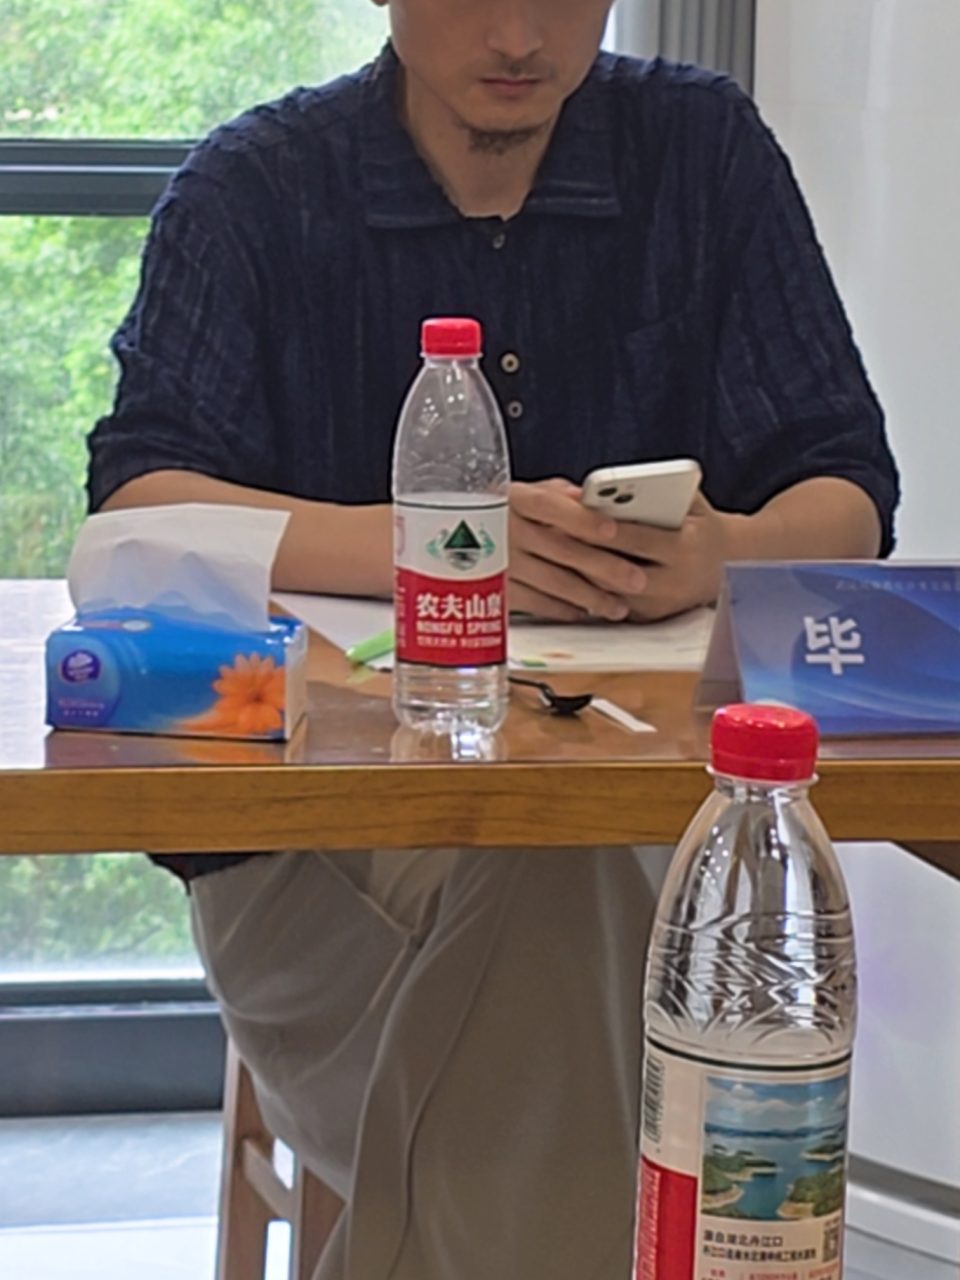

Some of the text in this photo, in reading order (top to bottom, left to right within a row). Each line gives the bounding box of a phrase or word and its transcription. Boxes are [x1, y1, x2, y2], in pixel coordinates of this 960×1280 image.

[416, 593, 501, 619] 农夫山泉
[803, 616, 865, 675] 毕
